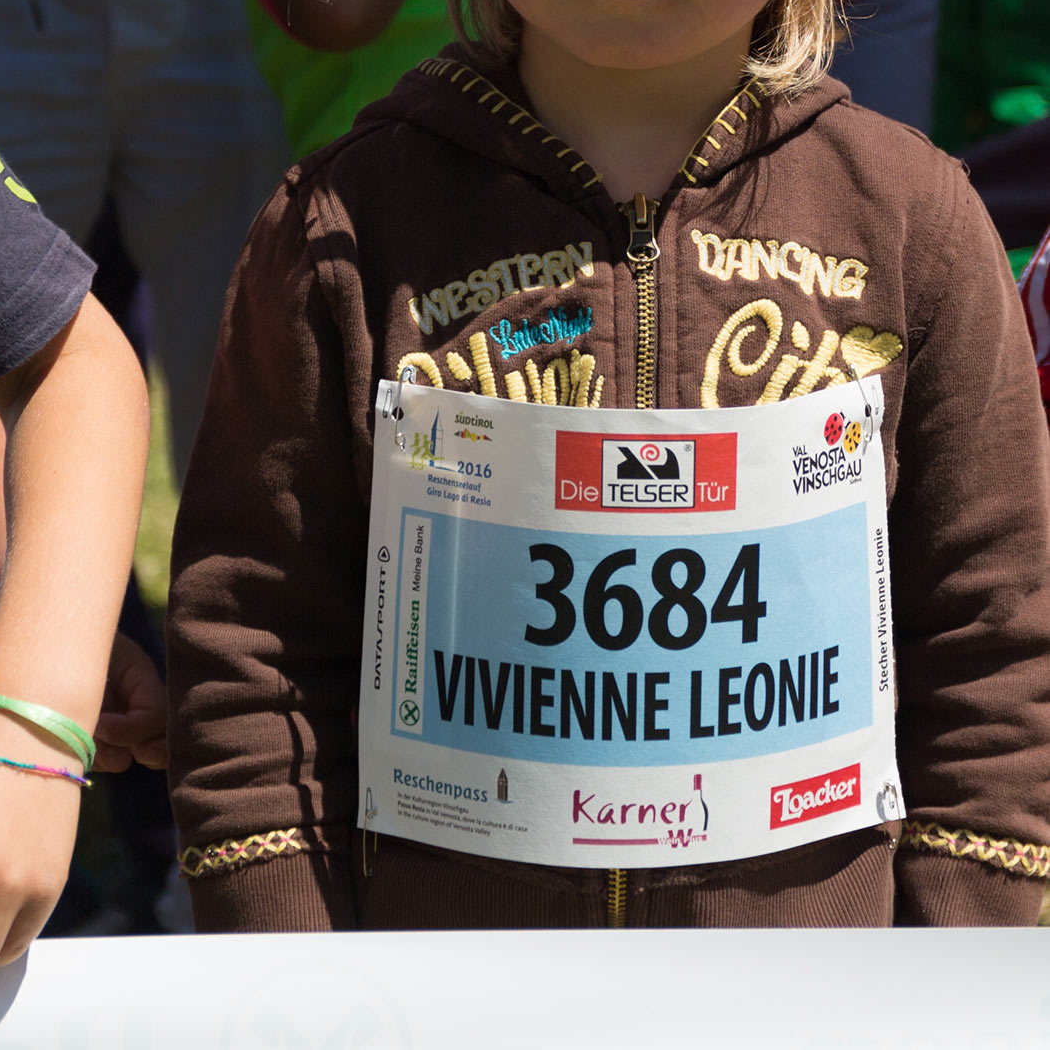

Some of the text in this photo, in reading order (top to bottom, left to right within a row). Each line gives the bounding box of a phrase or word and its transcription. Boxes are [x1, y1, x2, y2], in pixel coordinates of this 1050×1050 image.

[691, 229, 869, 300] DANCING
[409, 241, 594, 335] WESTERN
[792, 444, 807, 457] VAL
[793, 447, 846, 476] VENOSTA
[428, 474, 482, 494] Reschenseelauf
[457, 461, 492, 479] 2016
[793, 459, 862, 496] VINSCHGAU
[427, 487, 491, 507] Giro Lago di Resia
[561, 480, 729, 503] Die TELSER Tür
[404, 525, 424, 695] Raiffeisen Meine Bank
[524, 543, 767, 651] 3684
[874, 527, 889, 692] Stecher Vivienne Leonie
[374, 567, 386, 690] DATASPORT
[434, 645, 839, 741] VIVIENNE LEONIE
[393, 768, 488, 802] Reschenpass
[773, 776, 857, 823] Loacker
[572, 789, 693, 825] Karner
